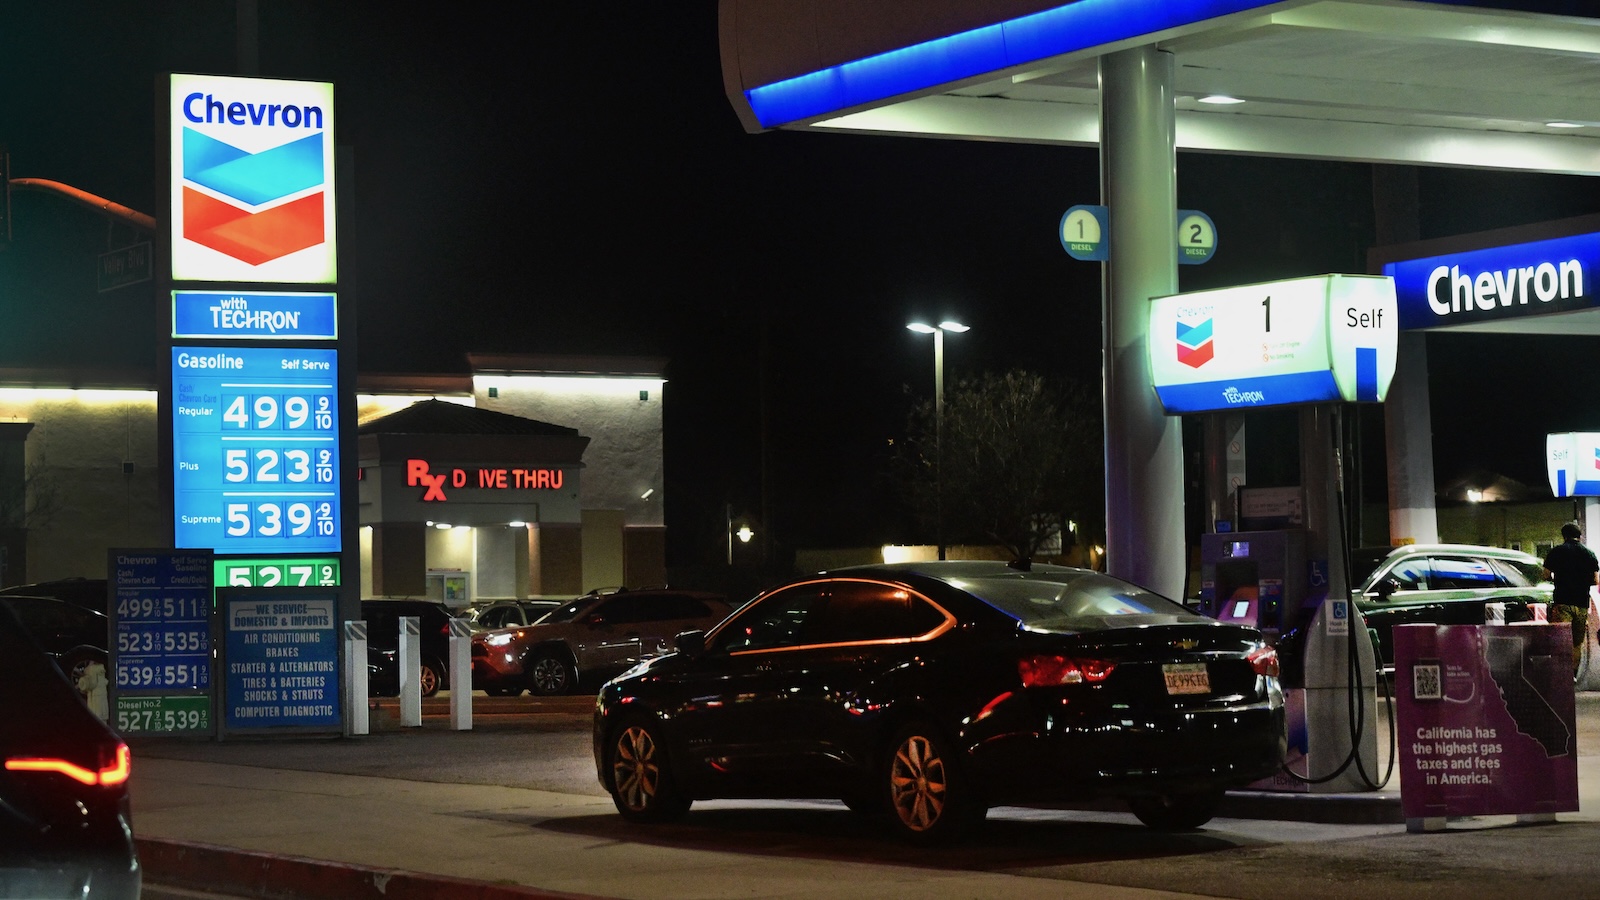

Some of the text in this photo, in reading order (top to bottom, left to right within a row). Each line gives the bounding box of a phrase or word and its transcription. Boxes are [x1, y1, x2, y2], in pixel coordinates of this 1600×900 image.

[183, 92, 323, 128] Chevron
[1077, 219, 1084, 239] 1
[1190, 224, 1202, 243] 2
[1071, 243, 1093, 251] DIESEL
[1185, 248, 1207, 256] DIESEL
[1427, 259, 1583, 315] Chevron
[220, 297, 248, 309] with
[1177, 306, 1214, 318] Chevron
[1262, 295, 1271, 333] 1
[209, 307, 299, 332] TECHRON
[1346, 308, 1384, 329] Self
[178, 353, 244, 369] Gasoline
[281, 359, 330, 370] Self Serve
[179, 384, 196, 393] Cash/
[179, 394, 217, 403] Chevron Card
[1222, 390, 1264, 405] TECHRON
[178, 406, 214, 417] Regular
[1553, 449, 1568, 460] Self
[179, 461, 199, 471] Plus
[512, 469, 563, 489] THRU
[181, 515, 221, 525] Supreme
[117, 556, 157, 565] Chevron
[171, 557, 207, 565] Self Serve
[117, 569, 134, 577] Cash/
[175, 564, 207, 572] Gasoline
[170, 576, 207, 584] Credit/Debit
[117, 599, 153, 618] 499
[256, 604, 308, 615] WE SERVICE
[234, 615, 329, 627] DOMESTIC & IMPORTS
[118, 632, 153, 652] 523
[164, 632, 200, 651] 535
[244, 632, 321, 644] AIR CONDITIONING
[265, 648, 299, 657] BRAKES
[231, 661, 334, 674] STARTER & ALTERNATORS
[118, 666, 153, 685] 539
[164, 665, 198, 684] 551
[242, 676, 326, 688] TIRES & BATTERIES
[244, 689, 324, 701] SHOCKS & STRUTS
[118, 700, 161, 710] Diesel No.2
[235, 705, 333, 718] COMPUTER DIAGNOSTIC
[118, 711, 153, 730] 527
[164, 710, 199, 730] 539
[1416, 726, 1496, 740] California has
[1412, 742, 1503, 757] the highest gas
[1416, 757, 1500, 770] taxes and fees
[1426, 772, 1493, 785] in America.
